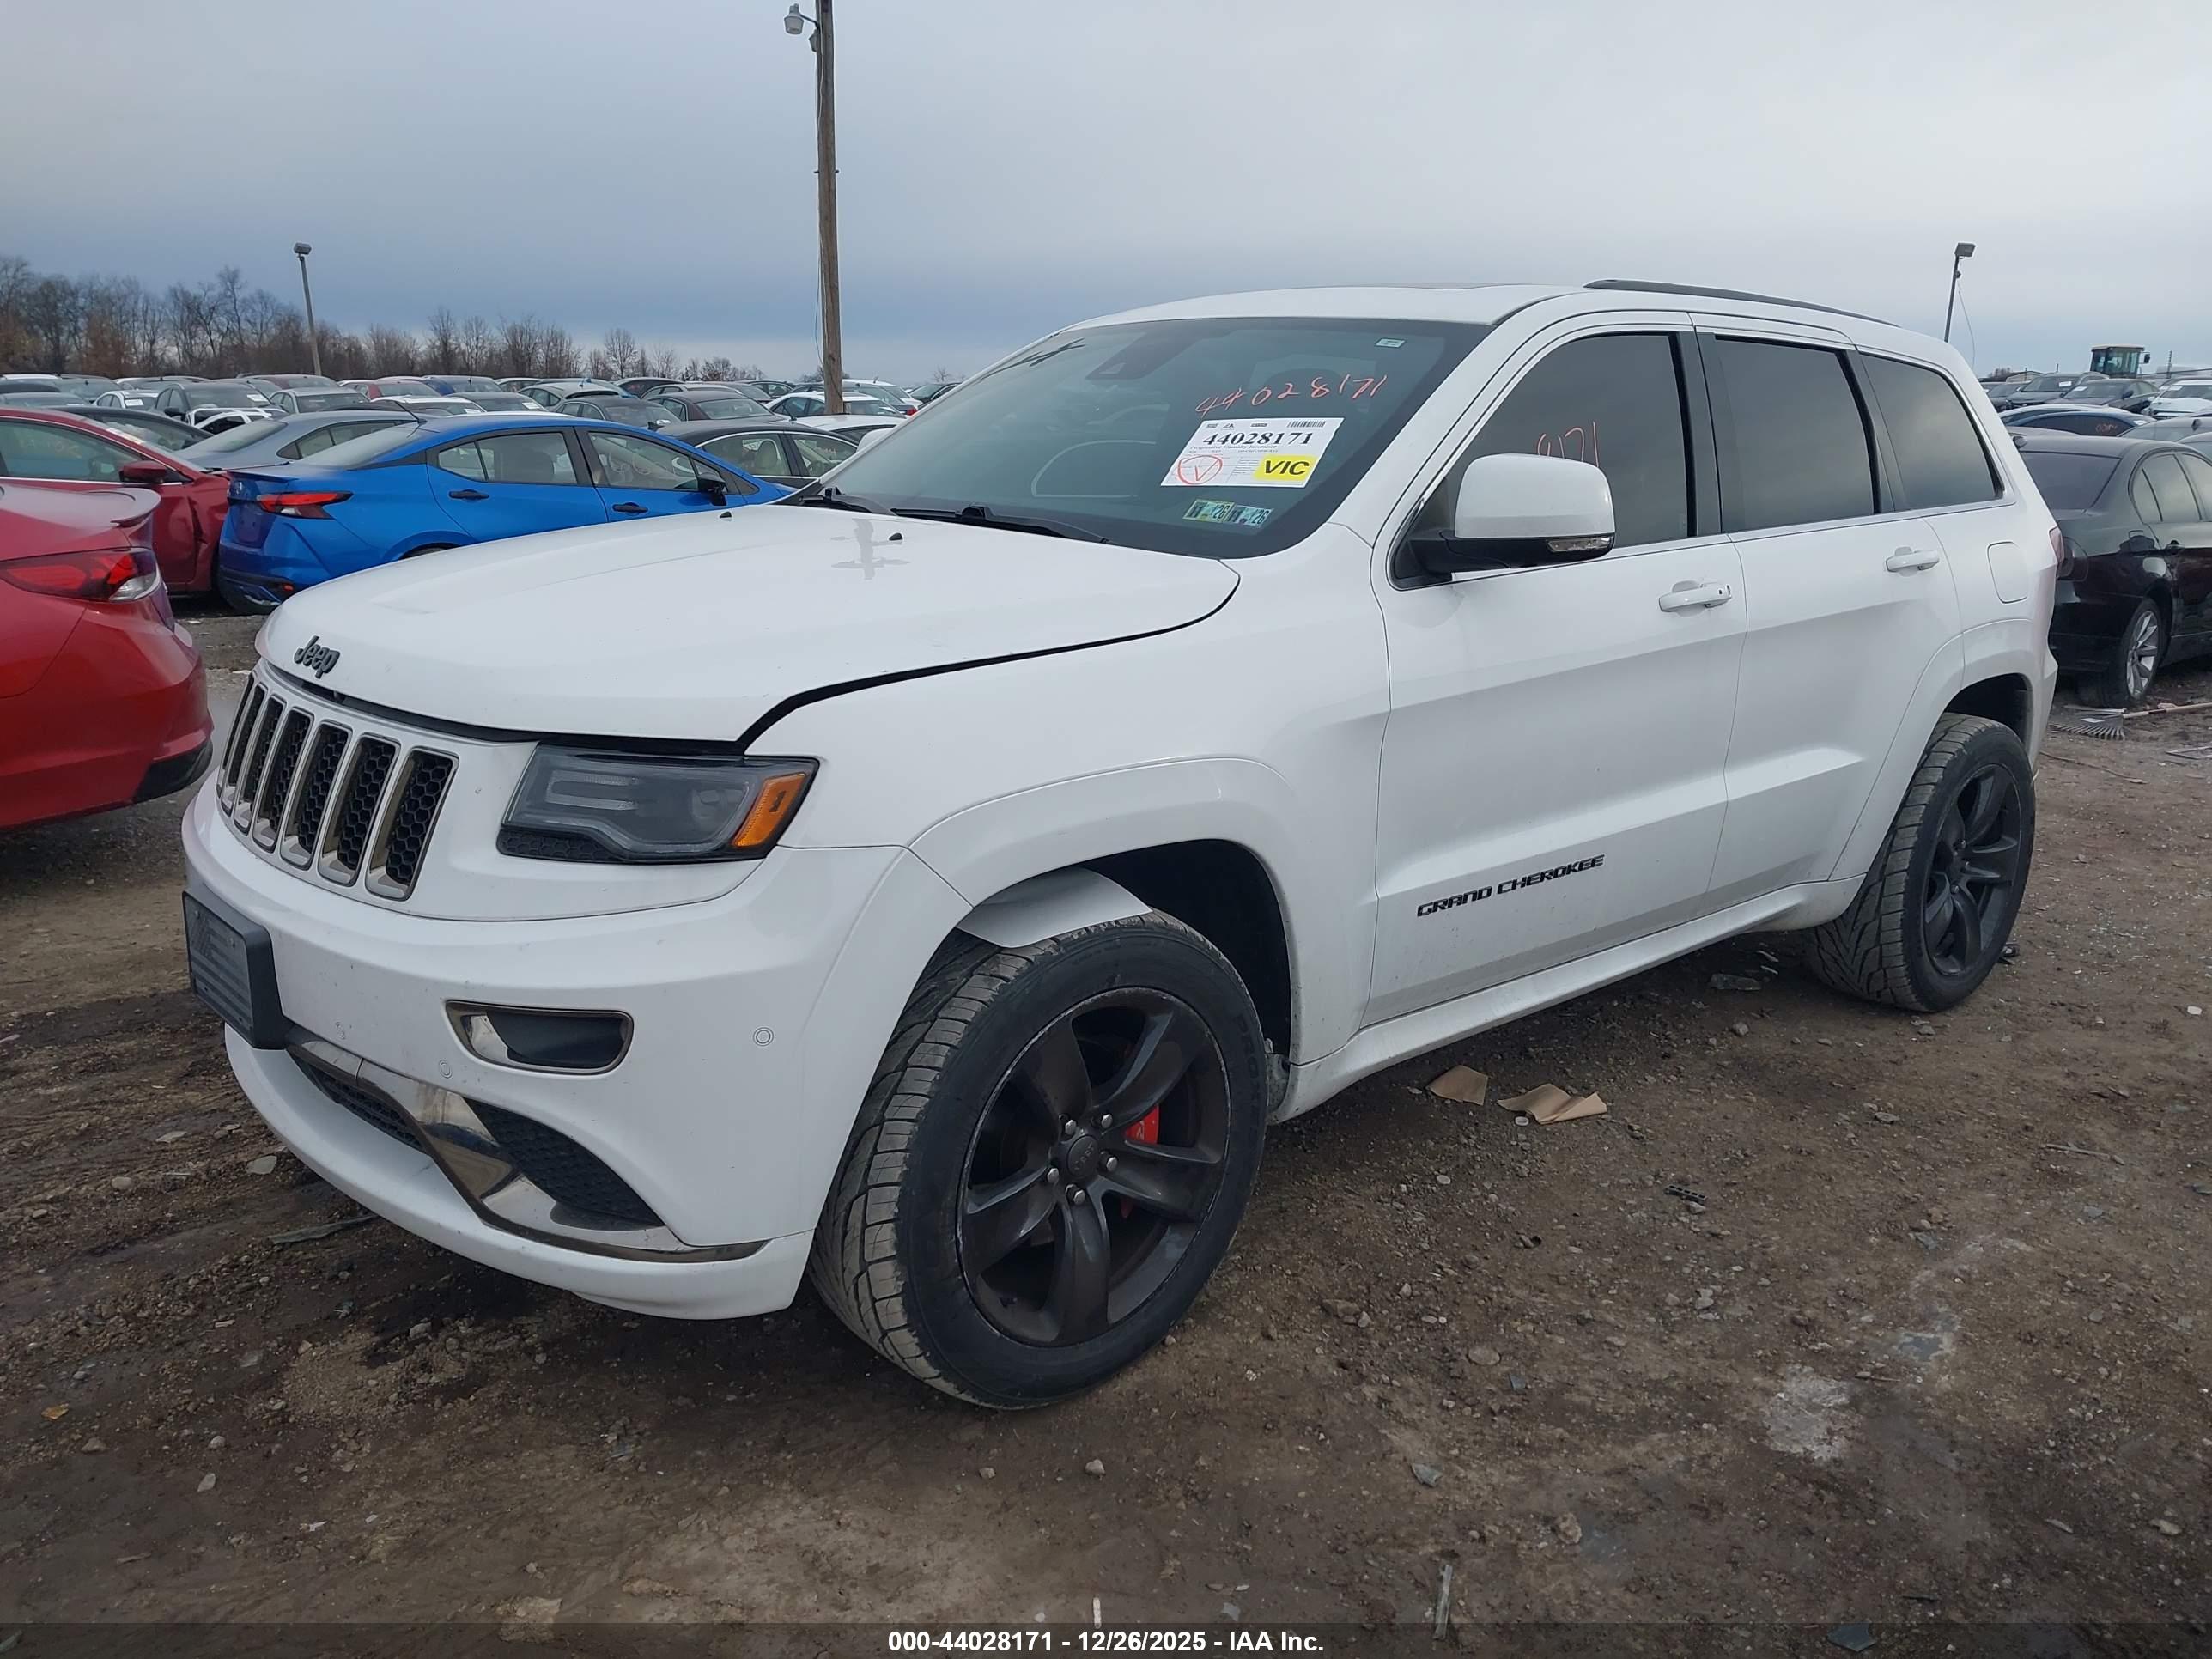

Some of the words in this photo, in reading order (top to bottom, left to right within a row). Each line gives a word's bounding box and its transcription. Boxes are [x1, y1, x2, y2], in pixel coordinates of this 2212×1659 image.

[1194, 373, 1389, 417] 44028171
[1202, 432, 1314, 446] 44028171
[1263, 460, 1310, 476] VIC
[293, 635, 341, 680] Jeep
[1417, 885, 1492, 917] GRAND
[1497, 854, 1606, 896] CHEROKEE
